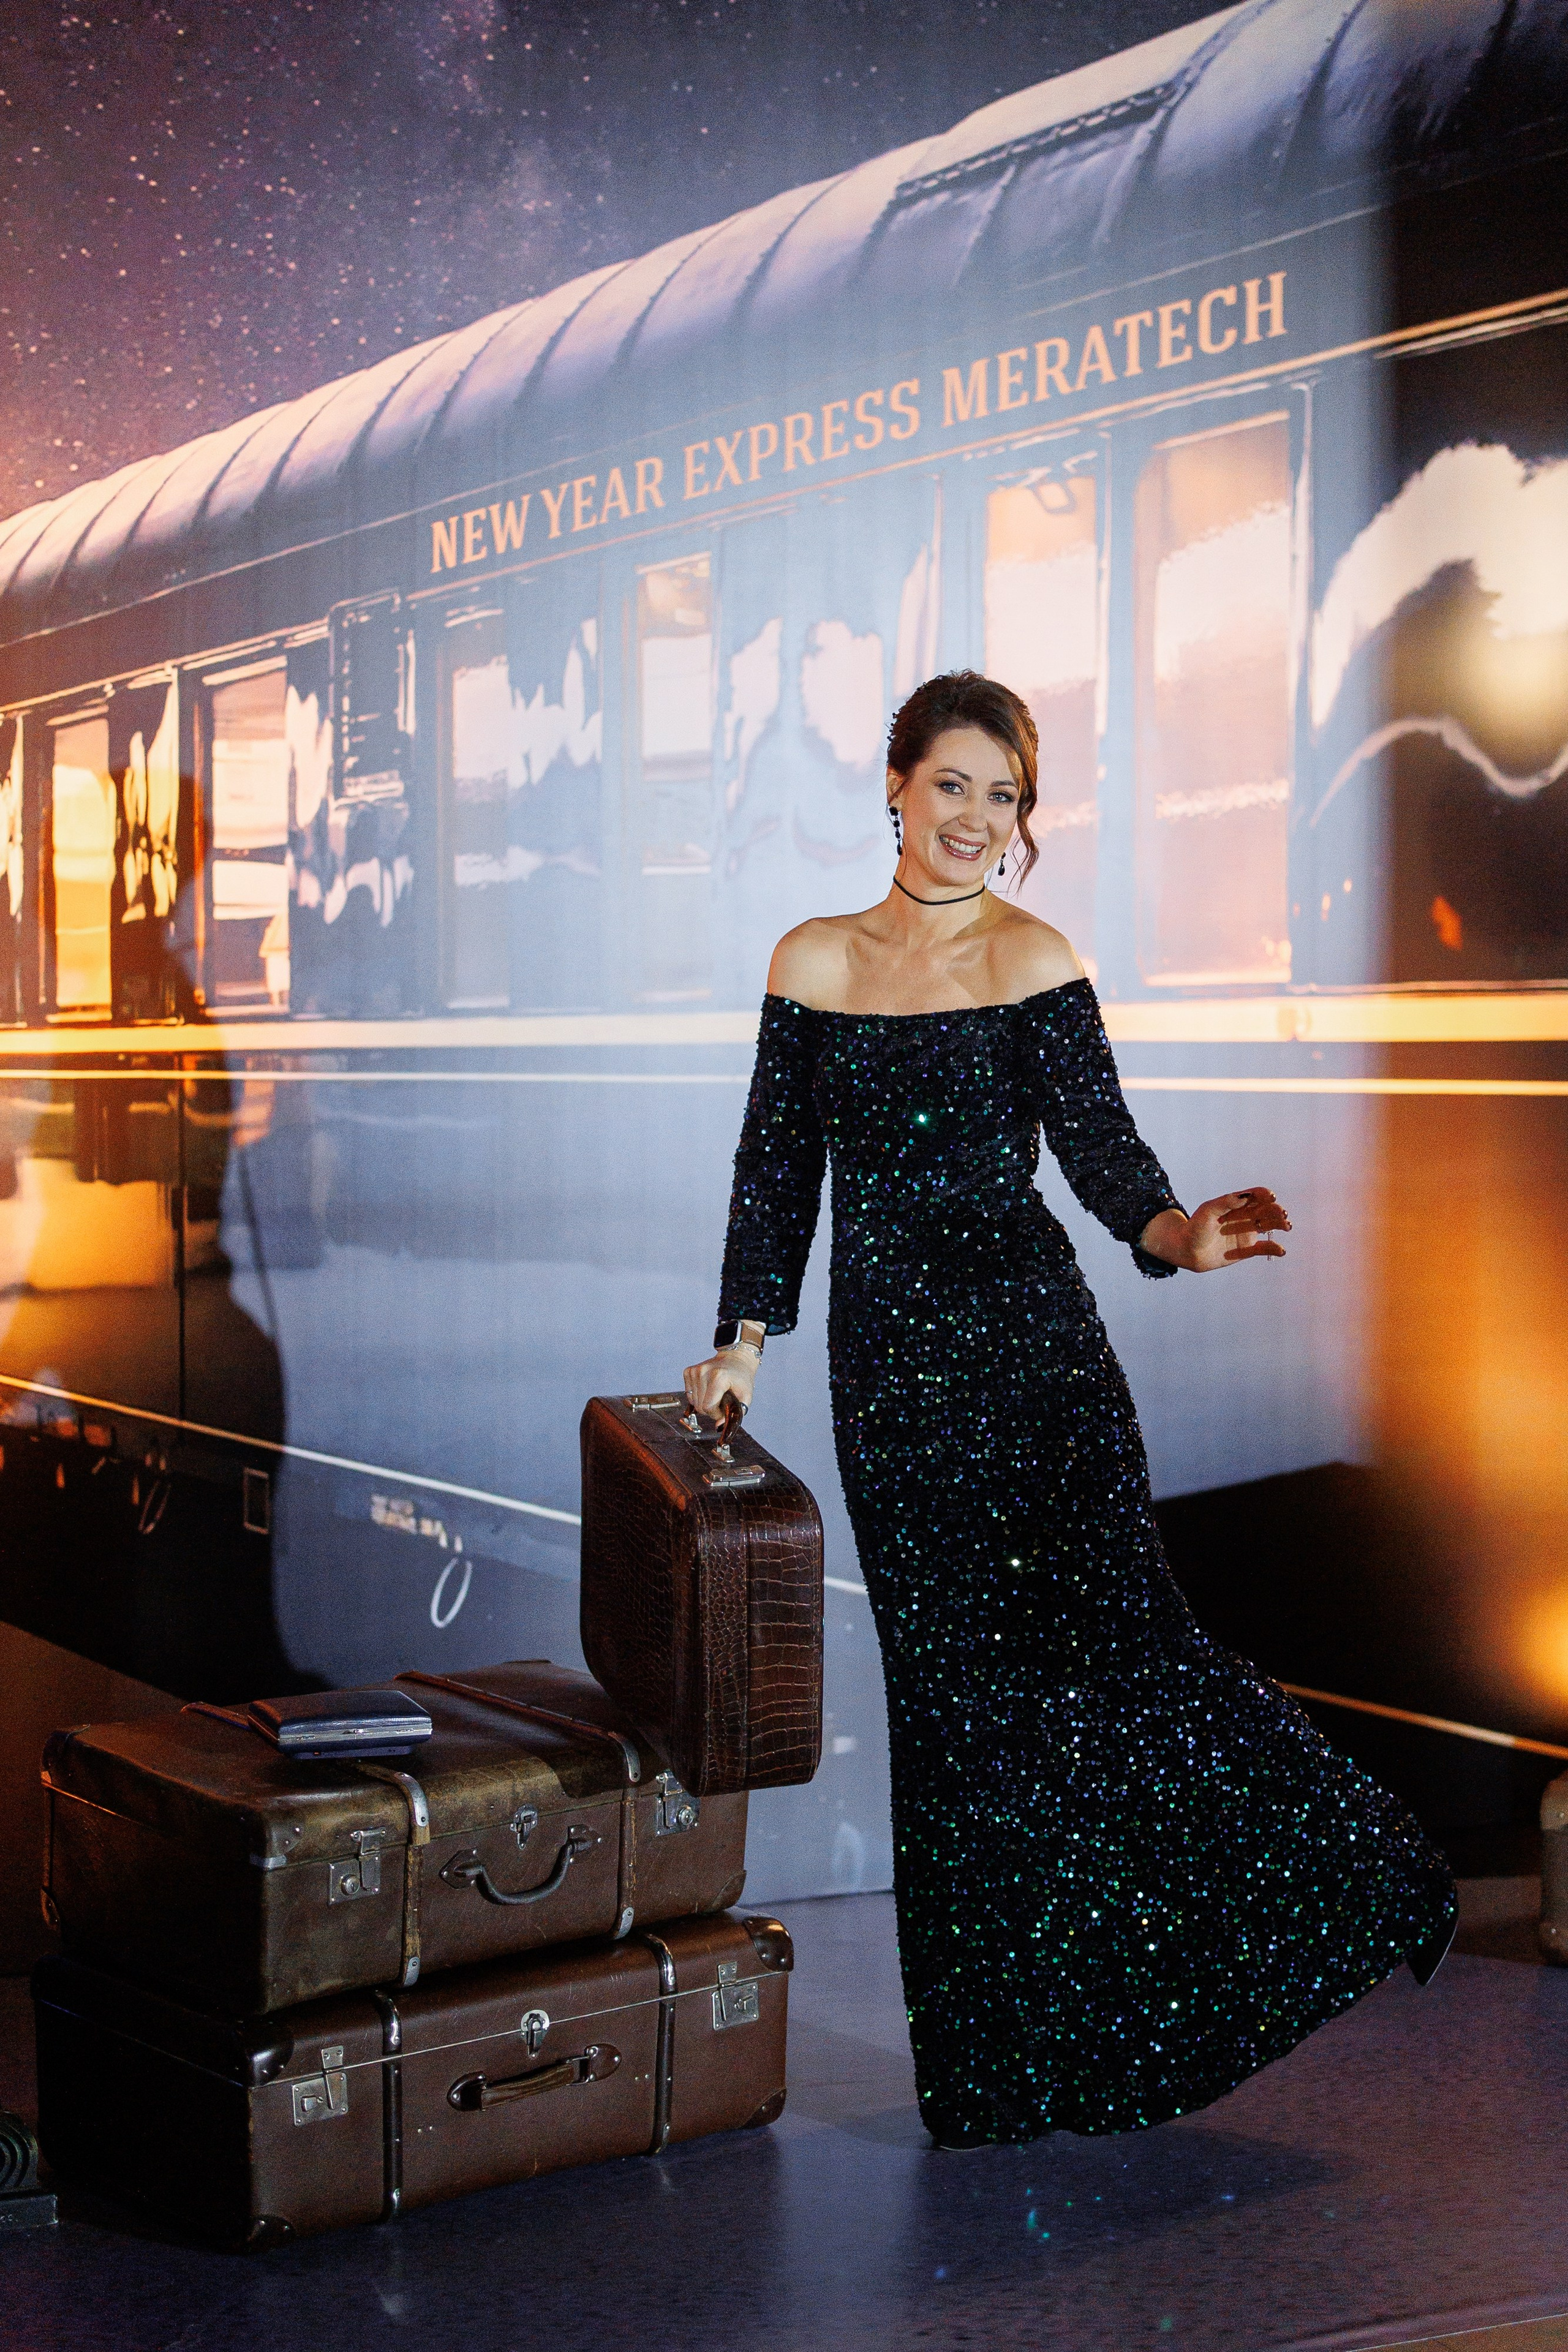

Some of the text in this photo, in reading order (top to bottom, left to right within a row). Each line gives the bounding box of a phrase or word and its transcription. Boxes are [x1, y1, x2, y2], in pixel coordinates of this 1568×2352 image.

[430, 271, 1287, 573] NEW YEAR EXPRESS MERATECH
